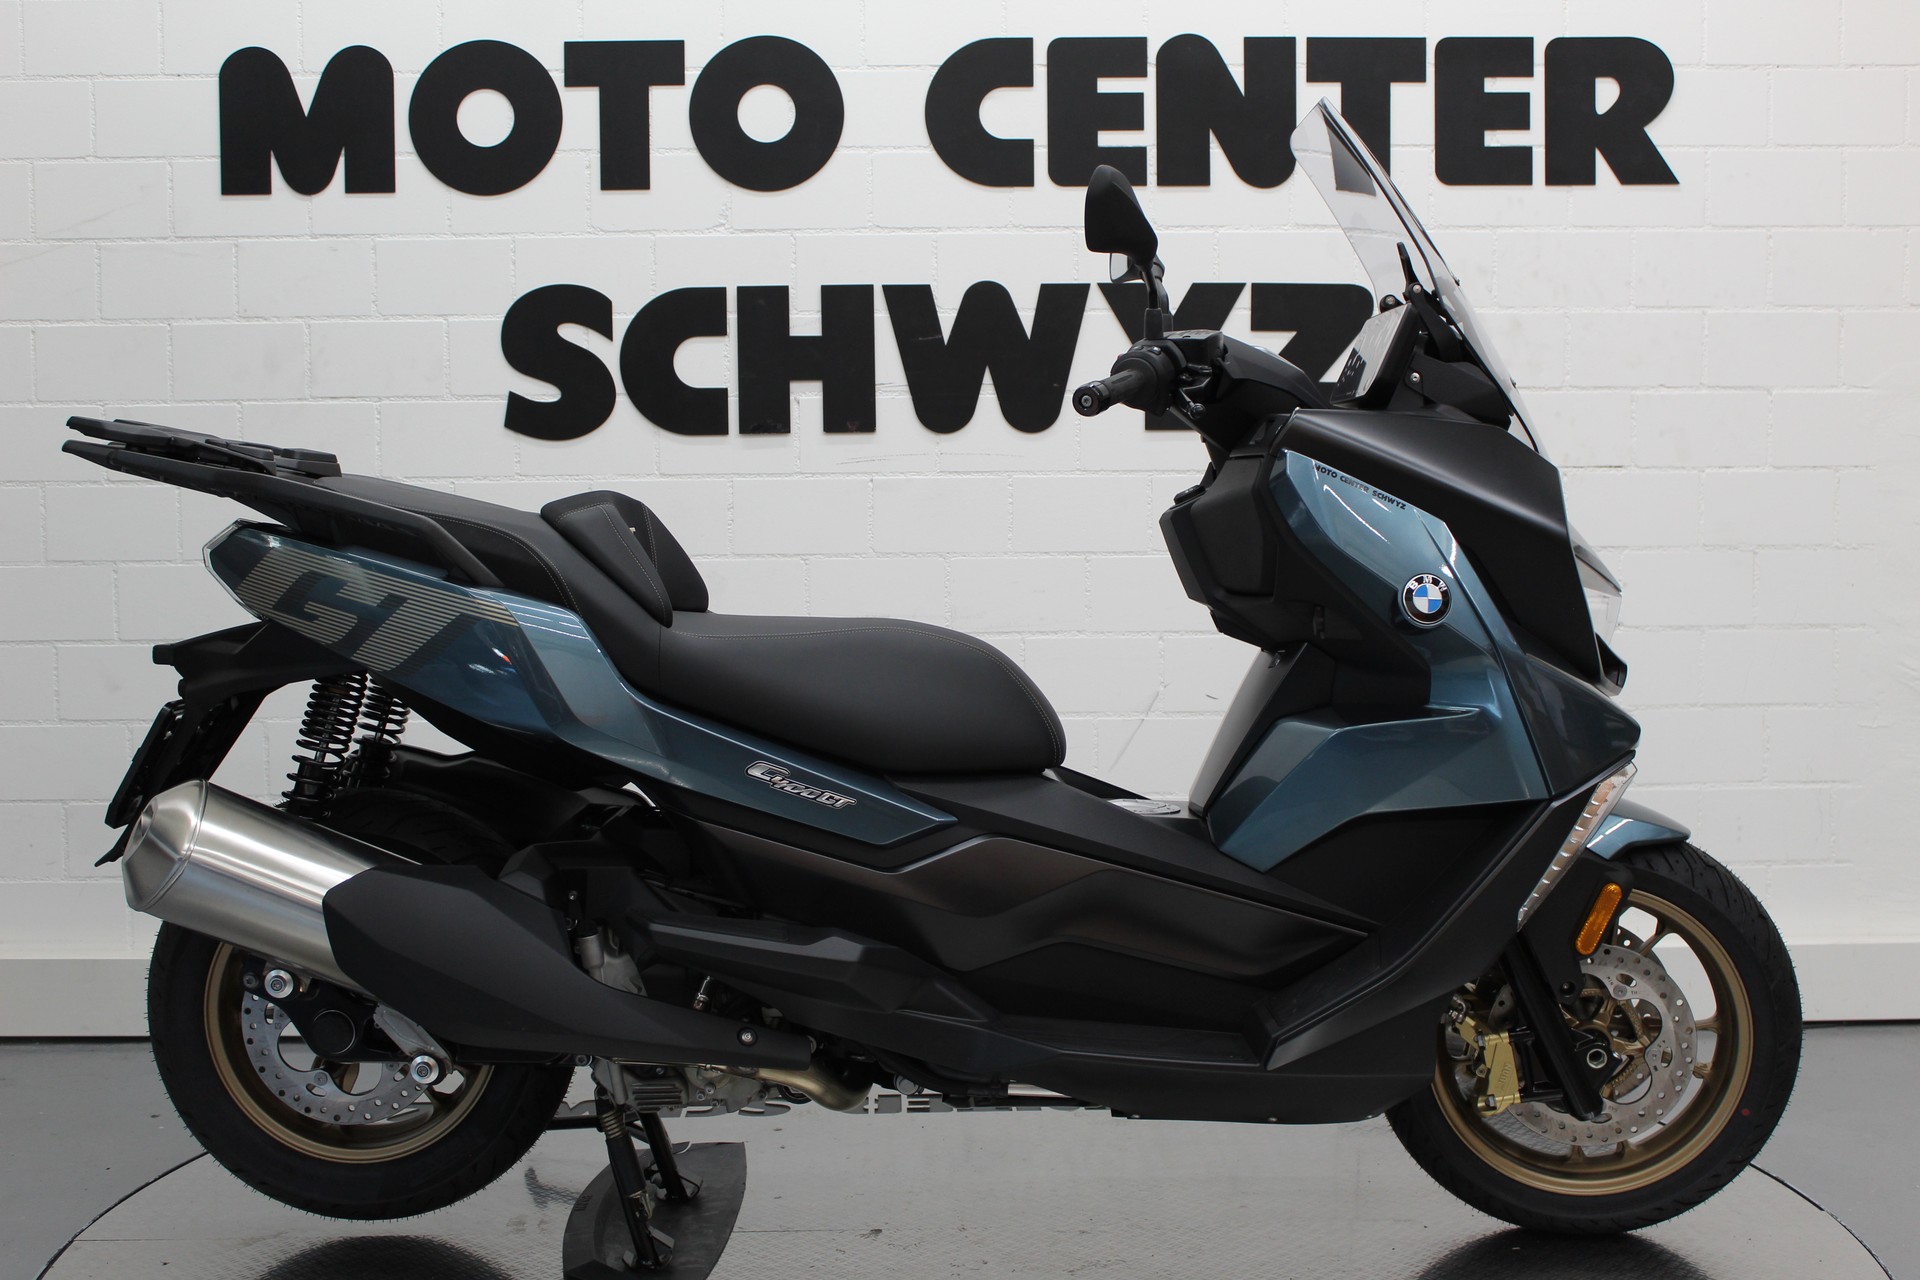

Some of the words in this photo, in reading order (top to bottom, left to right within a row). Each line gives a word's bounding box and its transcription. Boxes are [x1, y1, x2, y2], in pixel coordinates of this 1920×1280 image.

[219, 36, 845, 196] MOTO
[925, 34, 1680, 188] CENTER
[1339, 475, 1370, 493] CENTER
[1372, 490, 1407, 510] SCHWYZ
